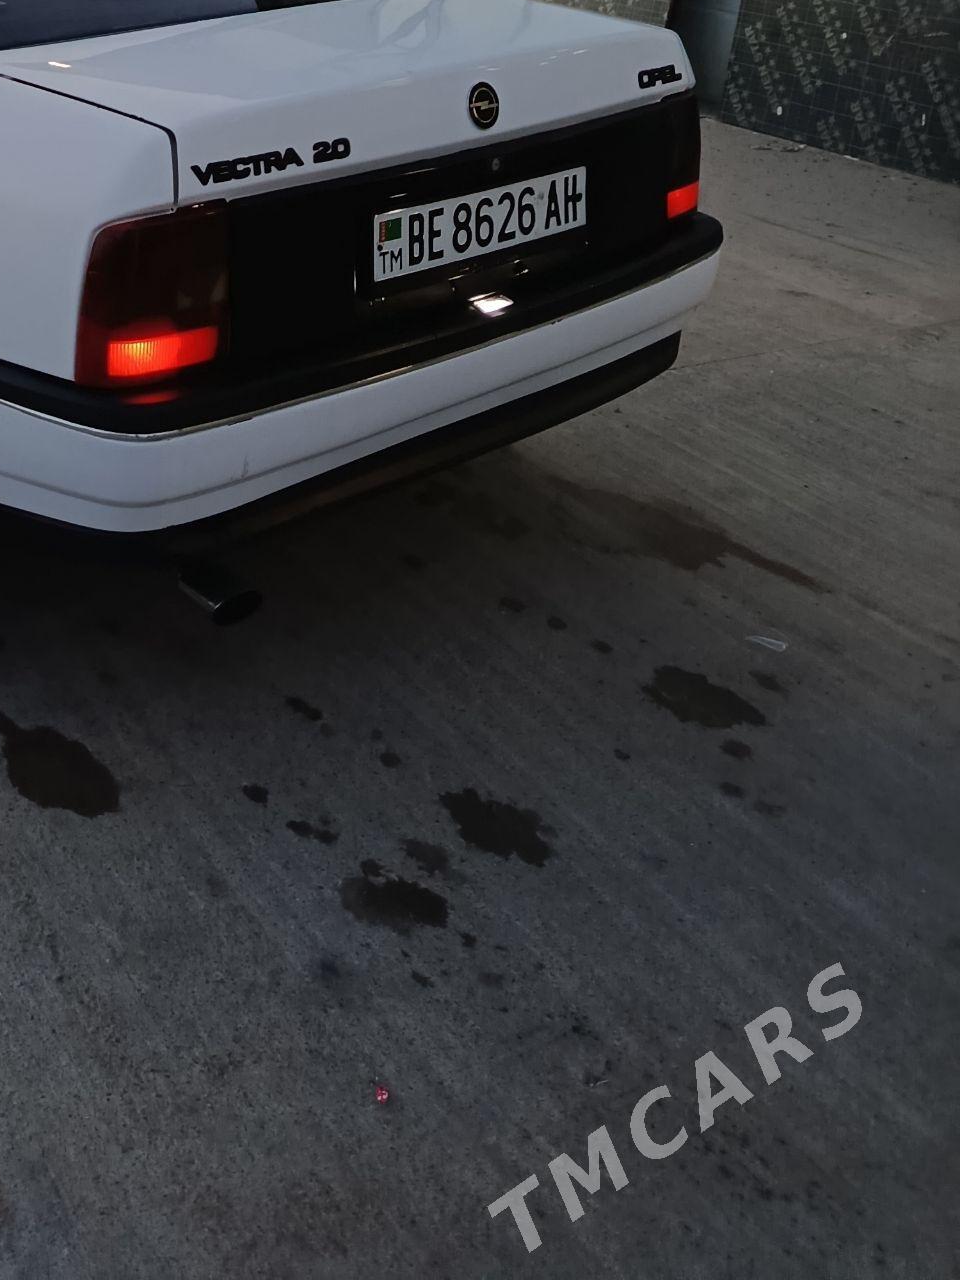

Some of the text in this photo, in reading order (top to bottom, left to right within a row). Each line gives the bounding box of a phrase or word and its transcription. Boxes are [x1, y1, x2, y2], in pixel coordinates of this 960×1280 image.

[638, 64, 682, 89] OPEL
[190, 147, 304, 186] VECTRA
[408, 174, 578, 266] BE 8626 AH
[379, 247, 403, 274] TM
